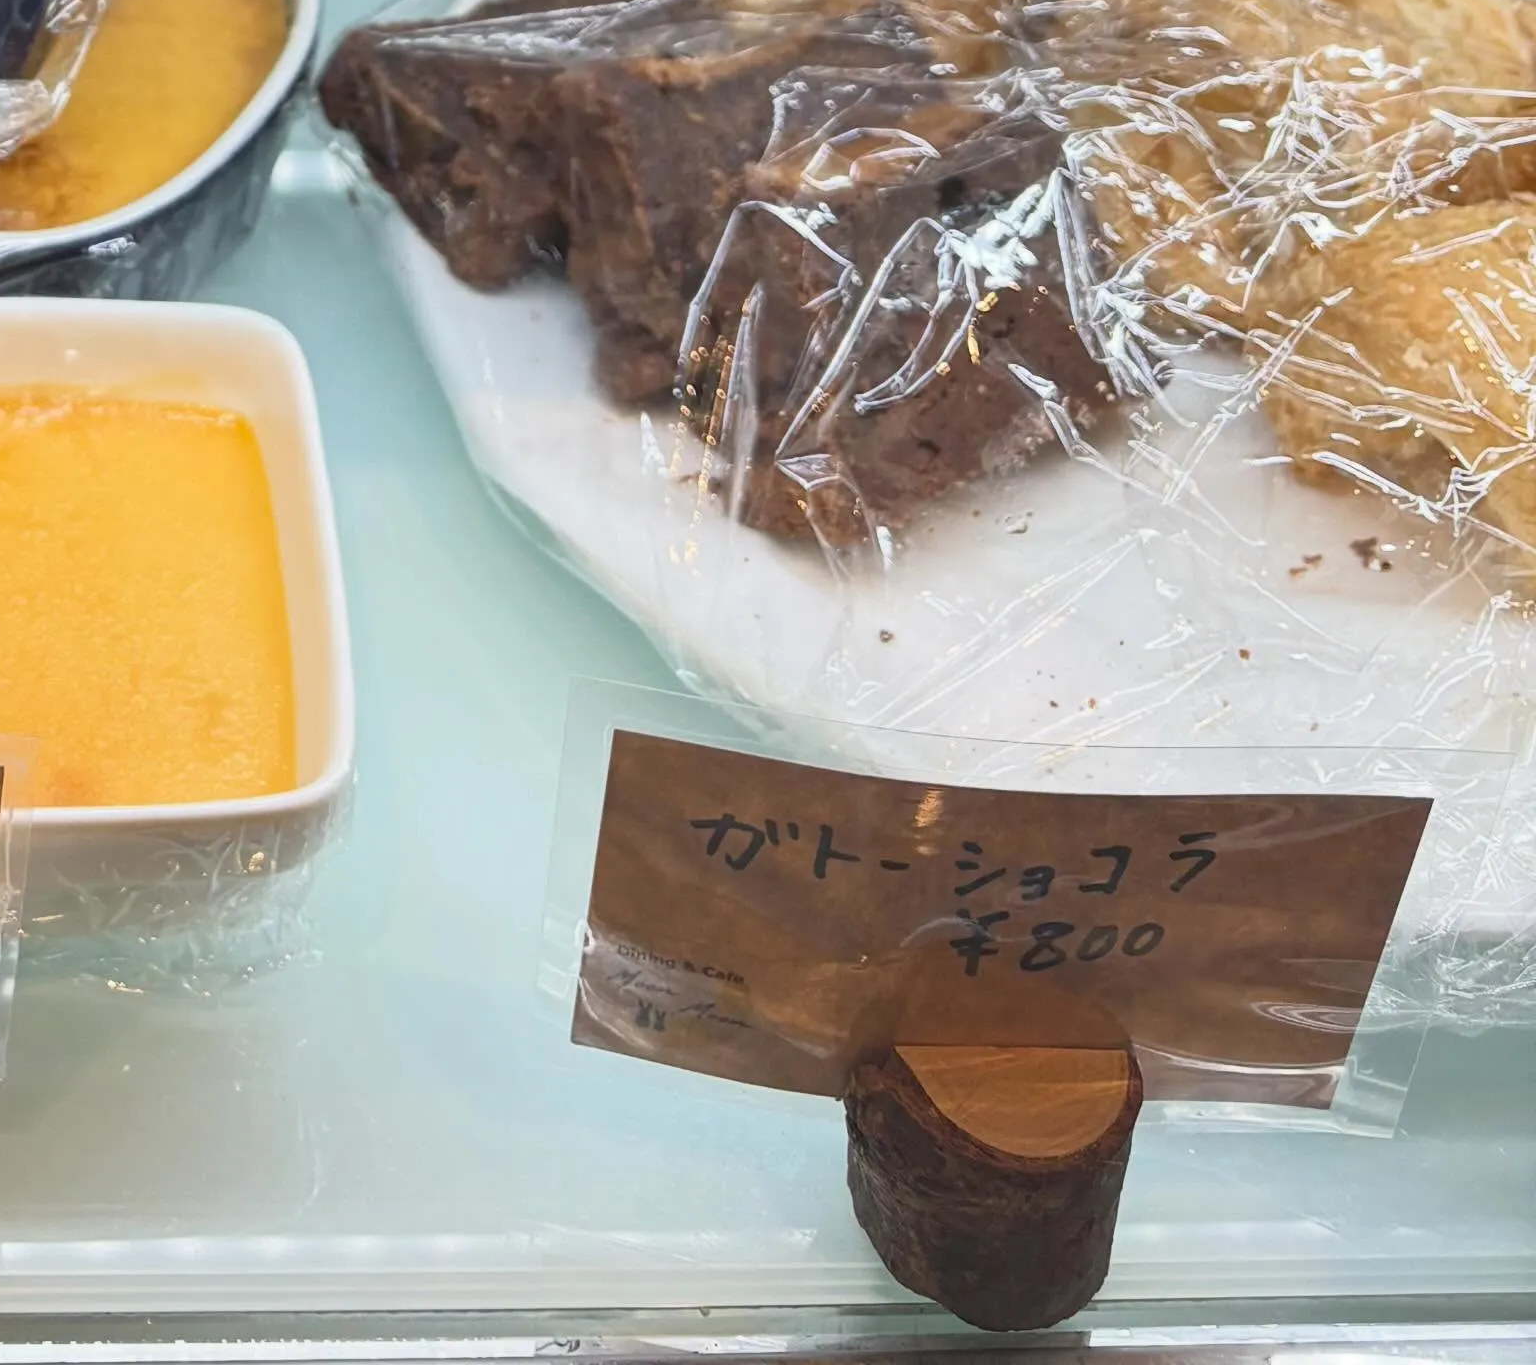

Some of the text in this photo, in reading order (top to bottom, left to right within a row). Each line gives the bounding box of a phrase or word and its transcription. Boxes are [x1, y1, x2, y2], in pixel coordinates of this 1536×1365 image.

[689, 812, 1218, 897] ガトーショコラ
[616, 943, 676, 970] Dining
[701, 966, 746, 986] Cafe
[949, 908, 1166, 975] ¥800
